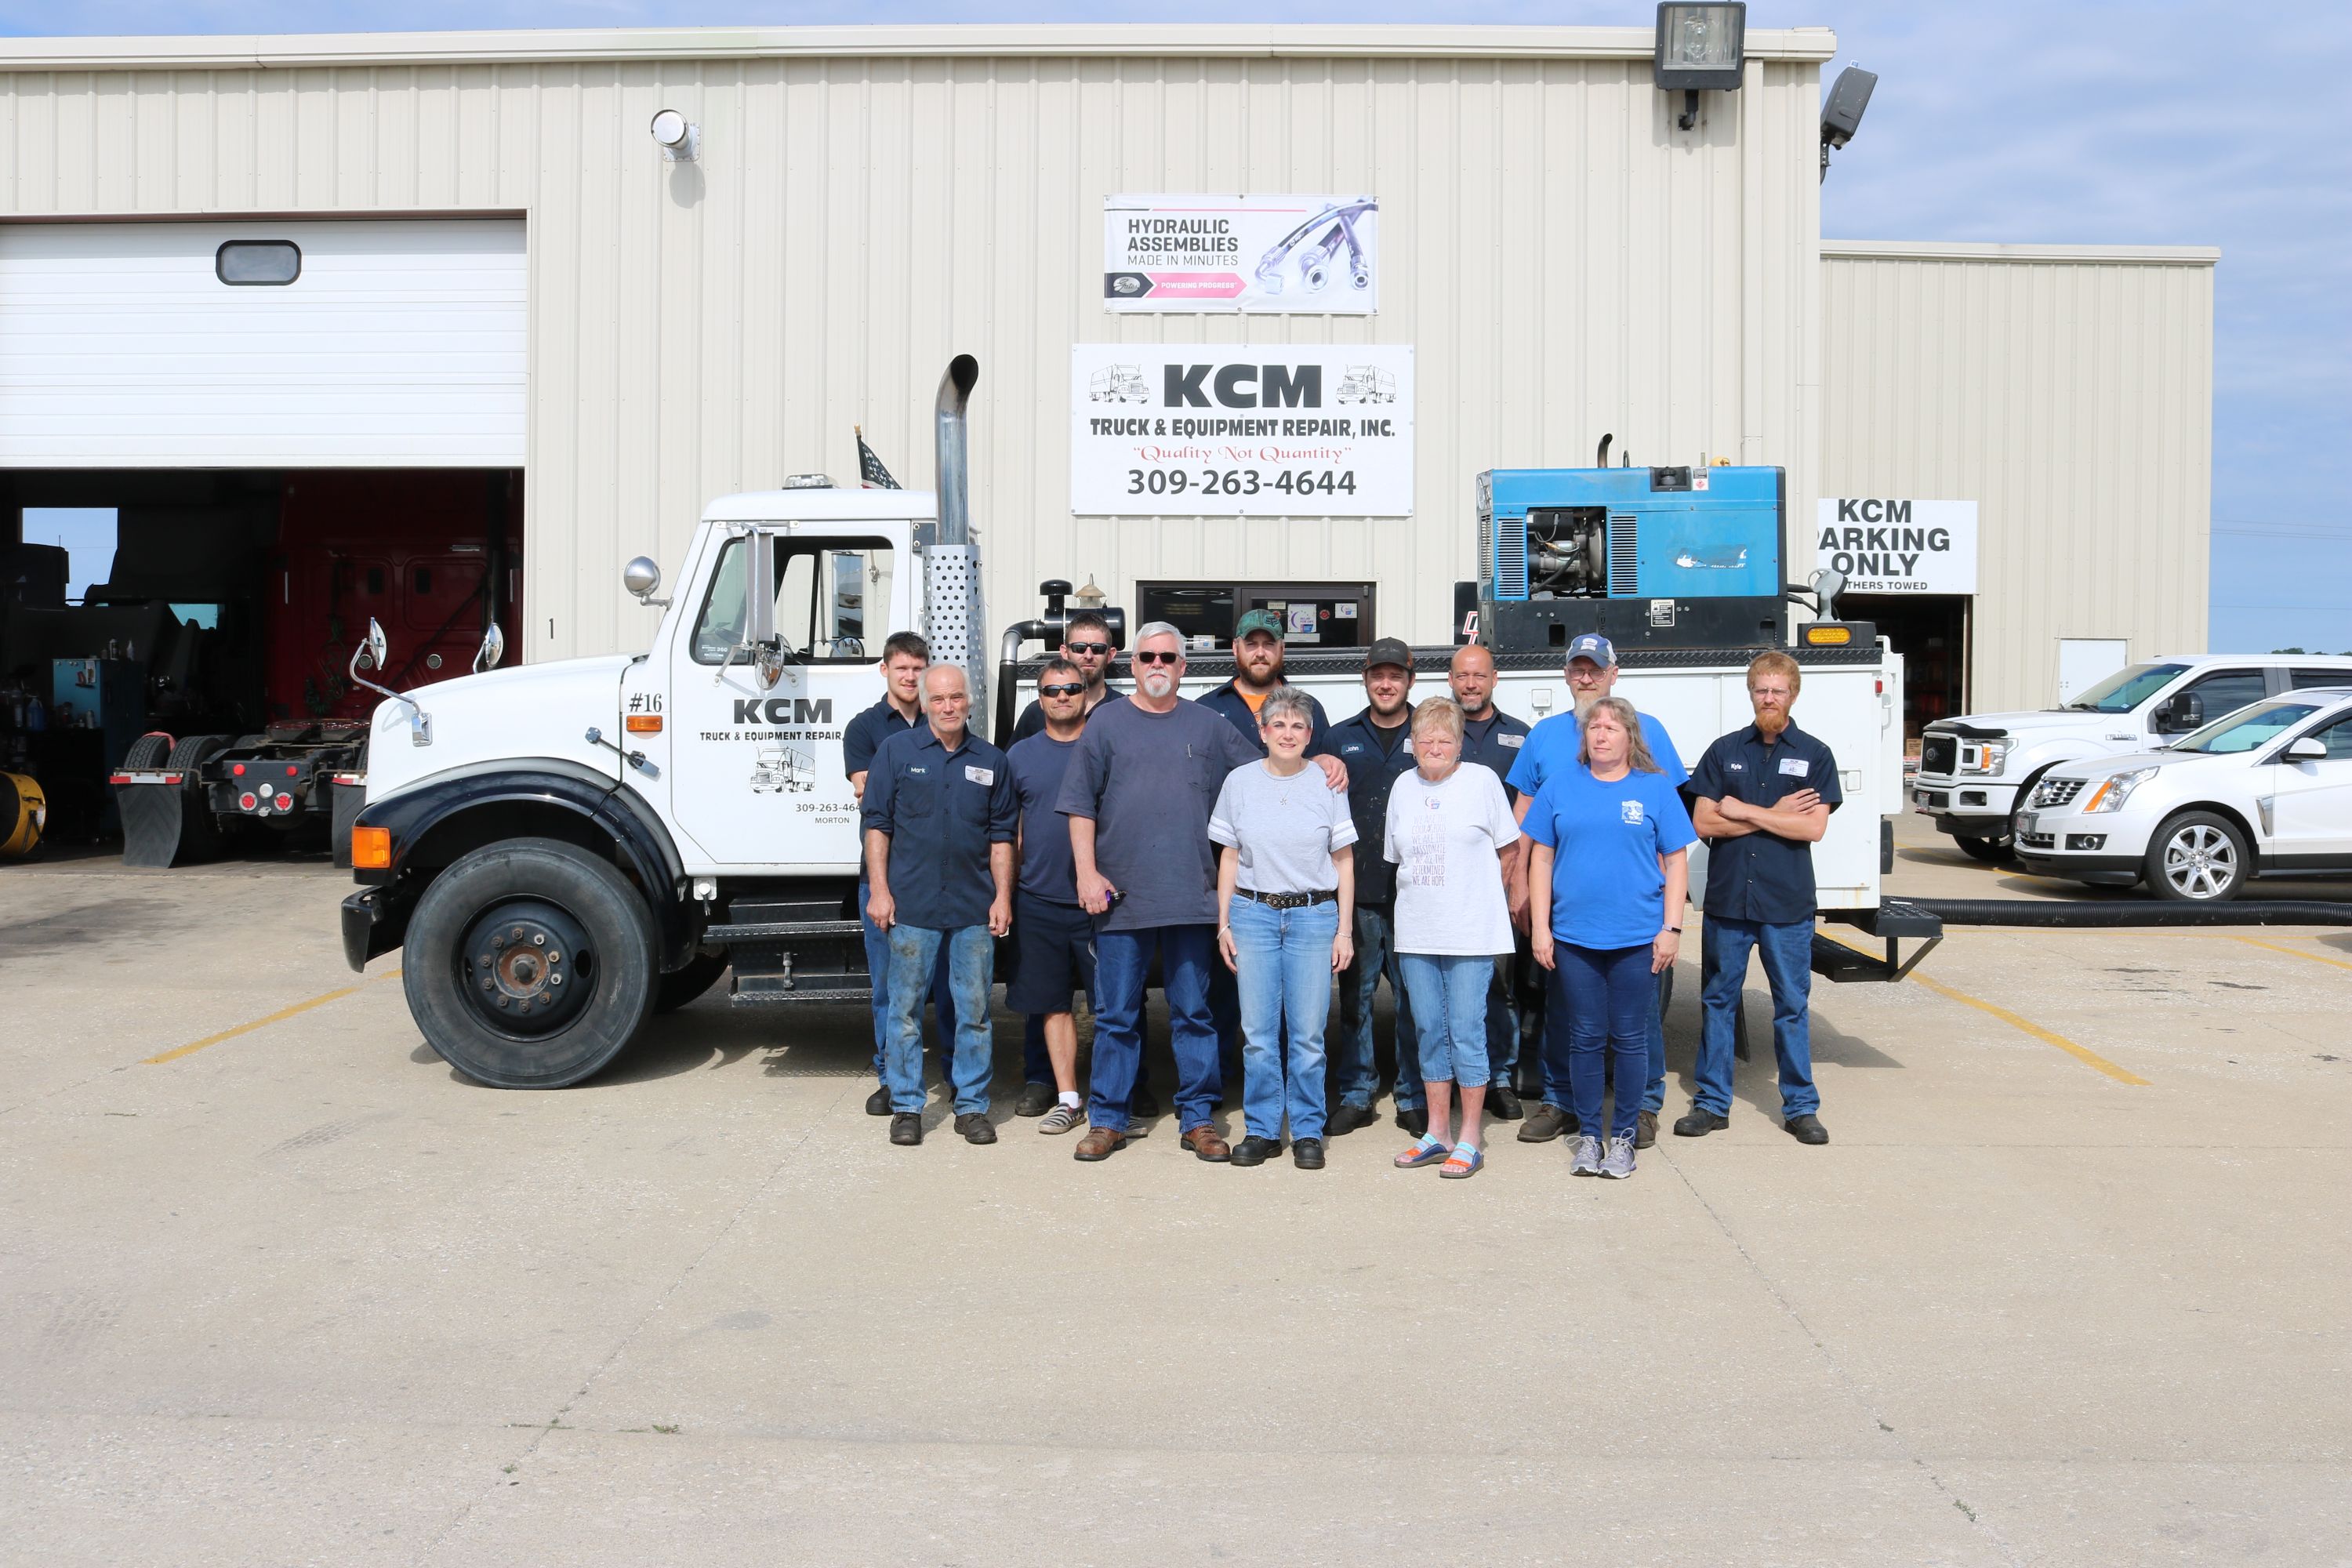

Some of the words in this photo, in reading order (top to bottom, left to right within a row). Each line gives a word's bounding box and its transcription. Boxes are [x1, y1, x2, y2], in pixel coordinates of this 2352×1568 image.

[1128, 219, 1229, 234] HYDRAULIC
[1127, 237, 1239, 252] ASSEMBLIES
[1127, 254, 1163, 266] MADE
[1167, 254, 1178, 266] IN
[1183, 254, 1239, 267] MINUTES
[1163, 363, 1322, 409] KCM
[1090, 419, 1150, 437] TRUCK
[1154, 419, 1167, 437] &
[1171, 419, 1279, 439] EQUIPMENT
[1283, 419, 1356, 440] REPAIR,
[1360, 419, 1396, 437] INC.
[1218, 446, 1253, 463] Not
[1127, 470, 1357, 495] 309-263-4644
[1838, 499, 1912, 524] KCM
[1817, 527, 1950, 552] ARKING
[1831, 552, 1920, 576] ONLY
[1847, 581, 1884, 590] THERS
[1887, 582, 1928, 590] TOWED
[549, 618, 554, 640] 1
[629, 692, 662, 713] #16
[733, 698, 833, 725] KCM
[699, 731, 731, 741] TRUCK
[734, 731, 740, 741] &
[744, 731, 802, 742] EQUIPMENT
[796, 804, 861, 812] 309-263-464
[1412, 834, 1421, 844] WE
[1423, 833, 1435, 844] ARE
[1436, 855, 1445, 864] THE
[1412, 865, 1445, 875] DETERMINED
[1412, 876, 1421, 886] WE
[1421, 876, 1430, 886] ARE
[1432, 876, 1445, 887] HOPE
